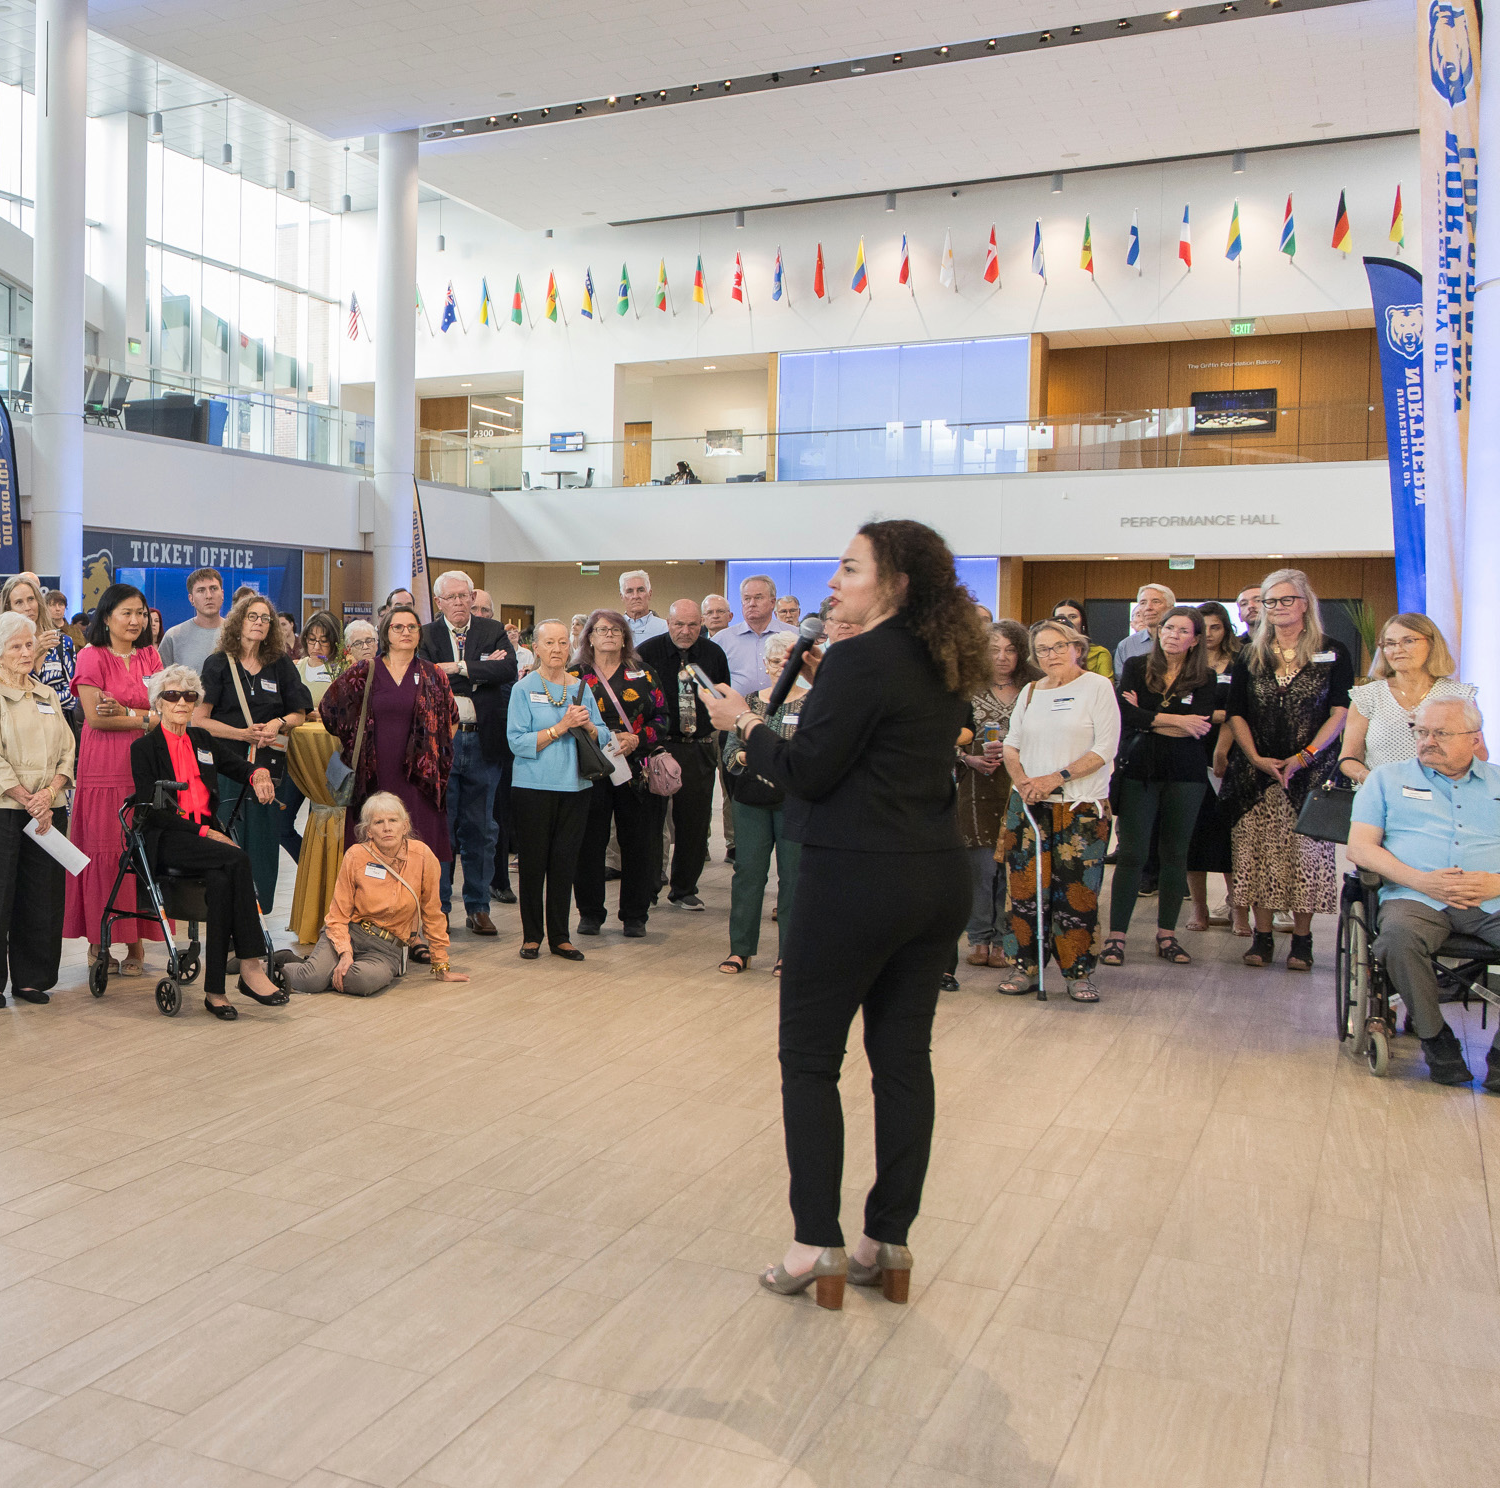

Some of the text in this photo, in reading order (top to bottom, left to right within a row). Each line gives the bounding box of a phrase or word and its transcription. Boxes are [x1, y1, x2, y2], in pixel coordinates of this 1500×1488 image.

[1234, 323, 1251, 335] EXIT
[1220, 360, 1255, 368] Foundation
[473, 429, 494, 438] 2300
[1120, 514, 1281, 528] PERFORMANCE HALL
[130, 540, 253, 569] TICKET OFFICE
